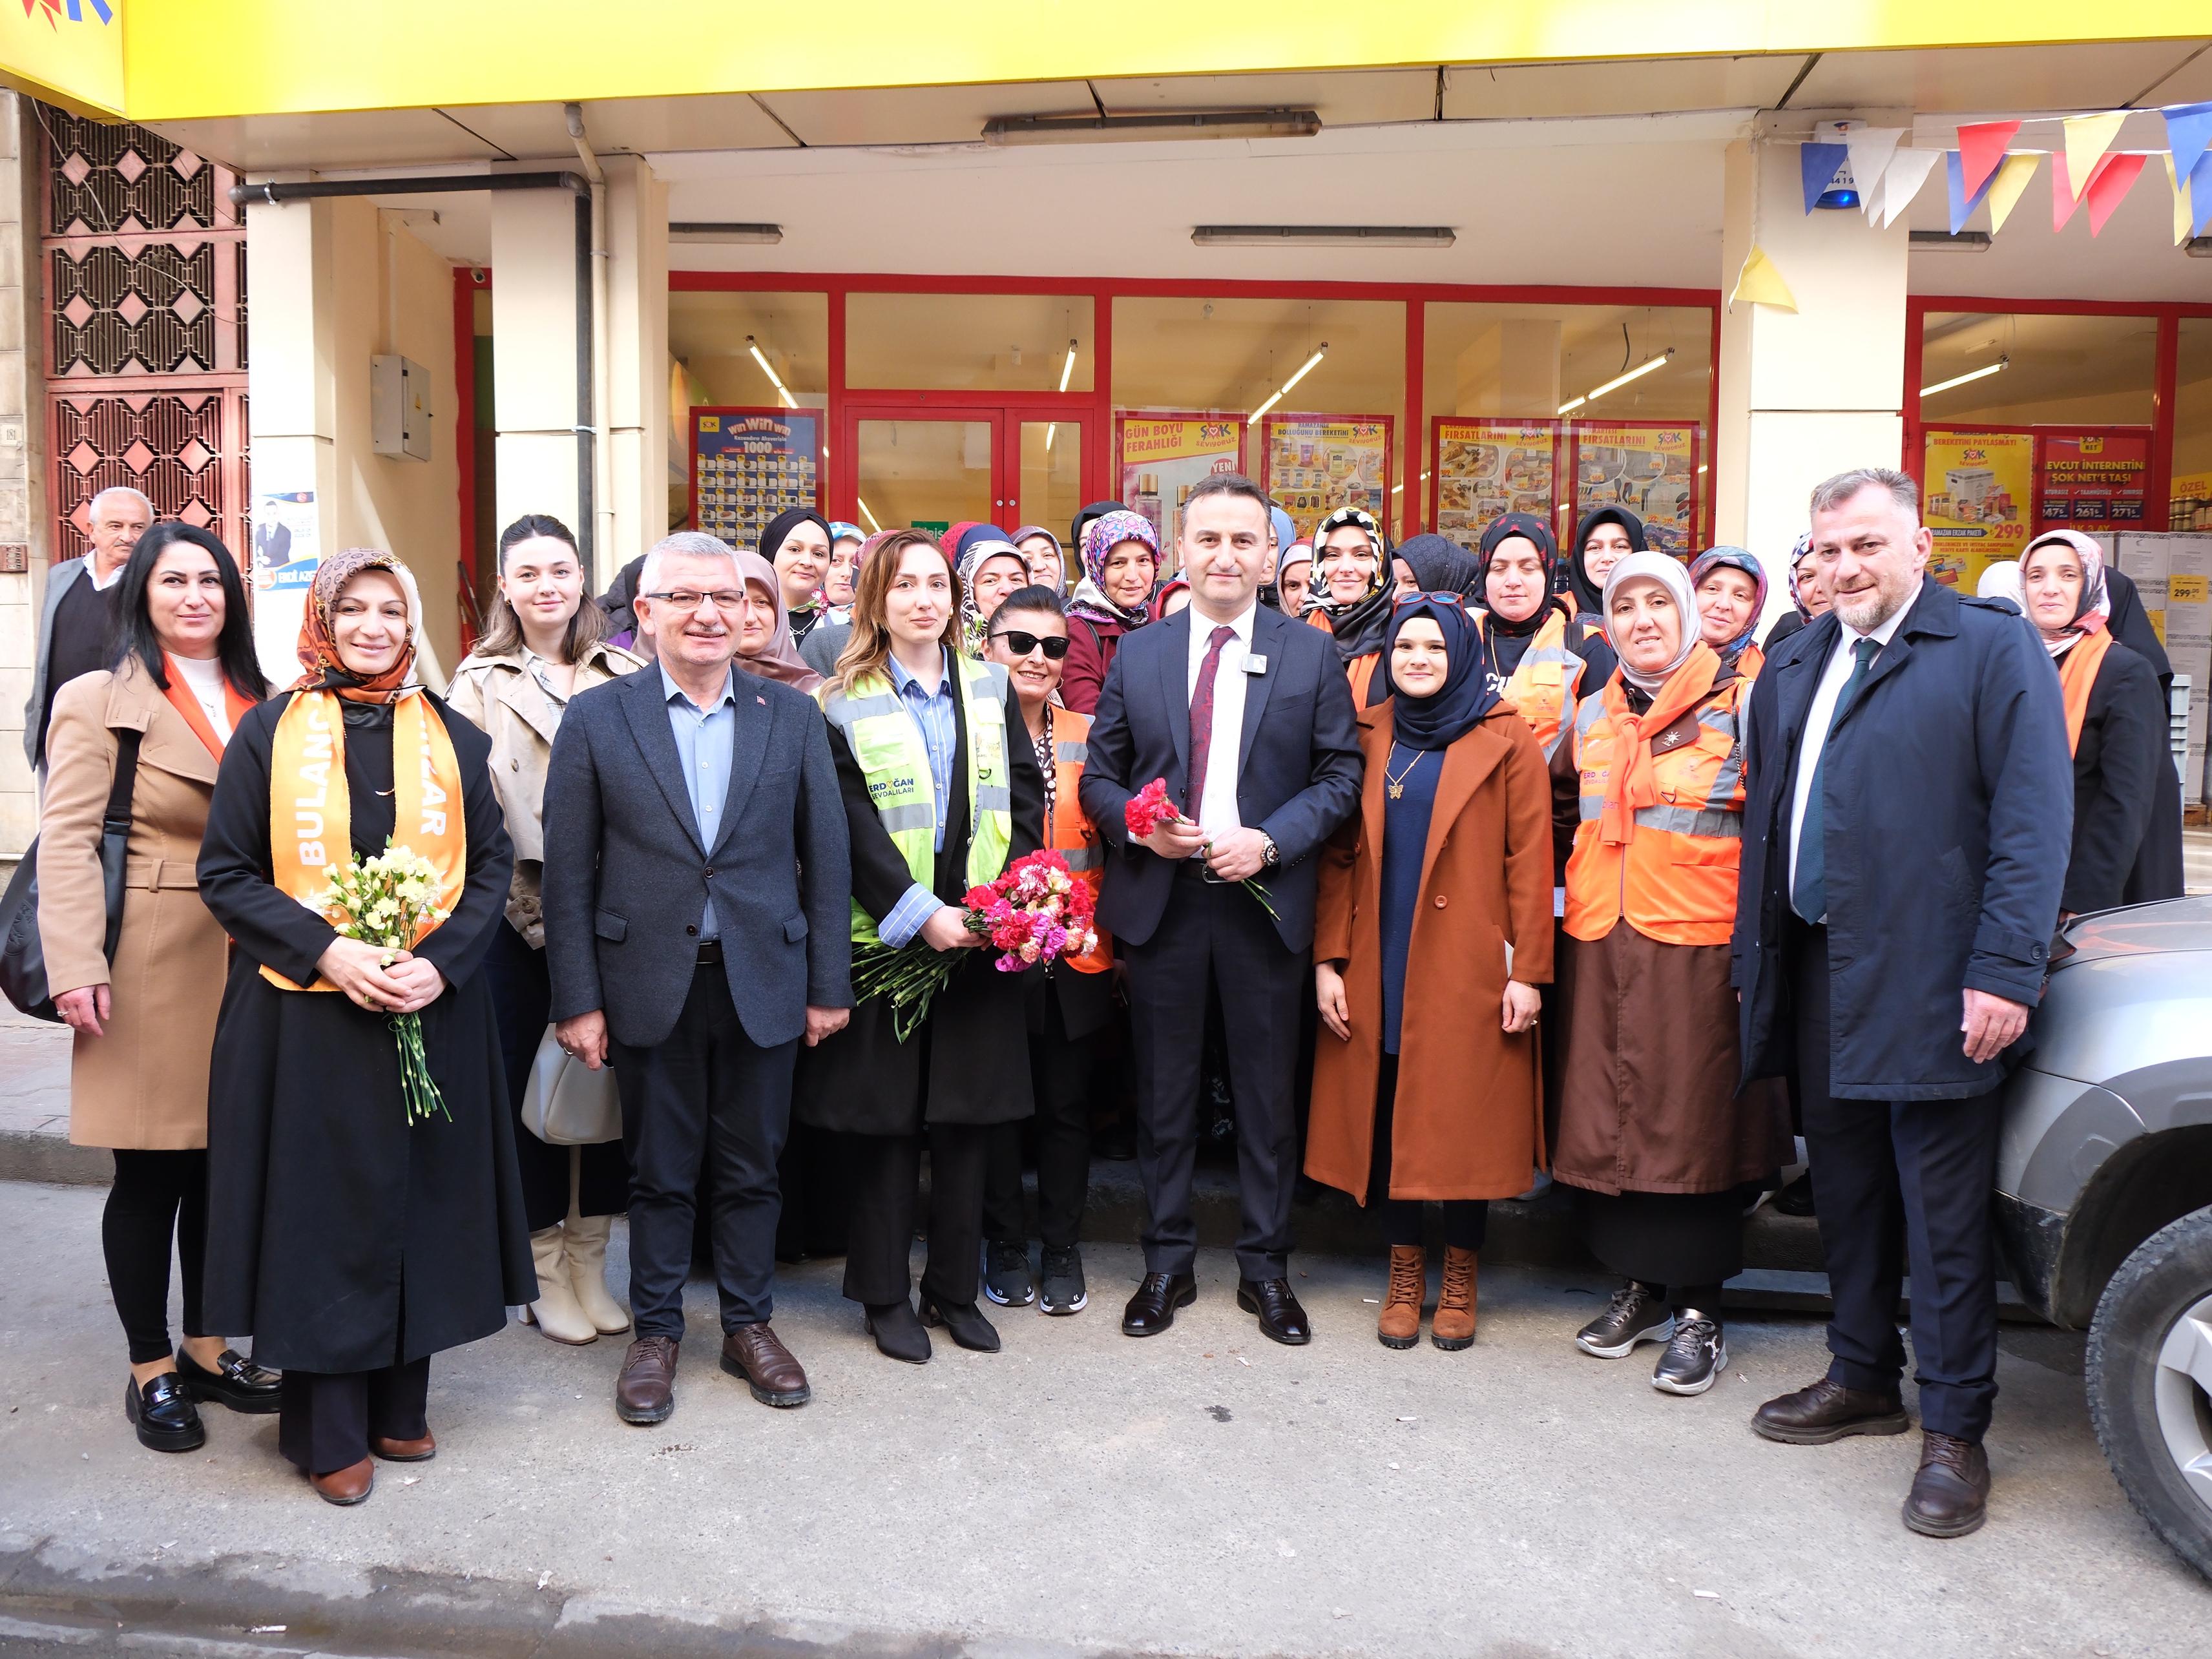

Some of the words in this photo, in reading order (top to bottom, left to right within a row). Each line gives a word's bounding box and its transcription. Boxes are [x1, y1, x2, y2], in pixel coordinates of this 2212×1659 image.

[6, 428, 16, 441] 181
[1125, 425, 1149, 439] GÜN
[1153, 423, 1184, 436] BOYU
[1445, 430, 1507, 440] FIRSATLARINI
[1126, 434, 1182, 453] FERAHLIĞI
[1583, 434, 1645, 445] FIRSATLARINI
[744, 441, 773, 454] 1000
[2045, 461, 2079, 470] EVCUT
[2051, 474, 2074, 485] ŞOK
[2109, 474, 2131, 485] TAŞI
[2180, 481, 2207, 493] ÖZEL
[871, 787, 914, 800] SEVDALILARI
